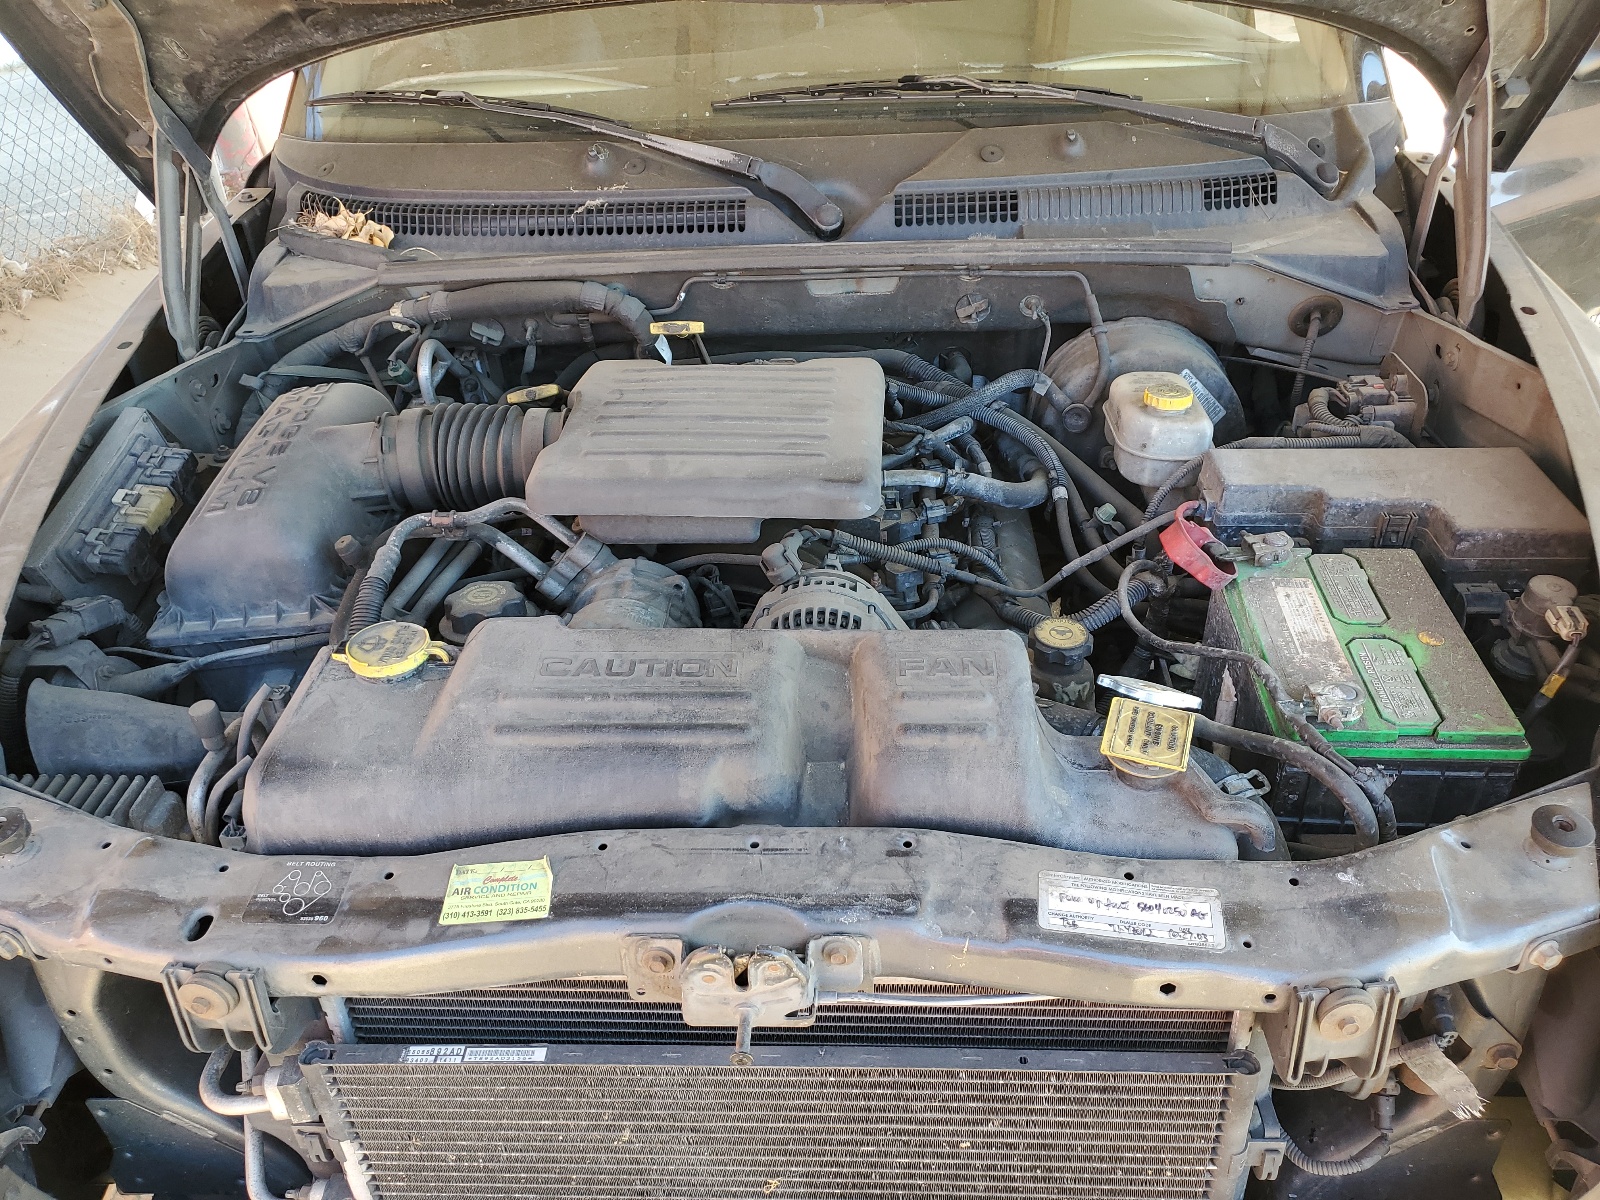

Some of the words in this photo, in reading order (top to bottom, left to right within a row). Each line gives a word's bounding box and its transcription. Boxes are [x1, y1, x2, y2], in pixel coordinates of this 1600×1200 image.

[236, 465, 278, 508] V8
[538, 657, 739, 678] CAUTION
[899, 657, 995, 677] FAN
[1359, 651, 1376, 675] POISON
[1371, 679, 1390, 703] DANGER
[1144, 711, 1156, 738] COOLANT
[1152, 723, 1164, 747] ENGINE
[1166, 724, 1179, 753] CAUTION
[452, 887, 472, 896] AIR
[473, 882, 538, 895] CONDITION
[483, 875, 519, 885] Complete
[443, 911, 460, 921] (310)
[461, 909, 493, 918] 413-3591
[496, 907, 514, 917] (323)
